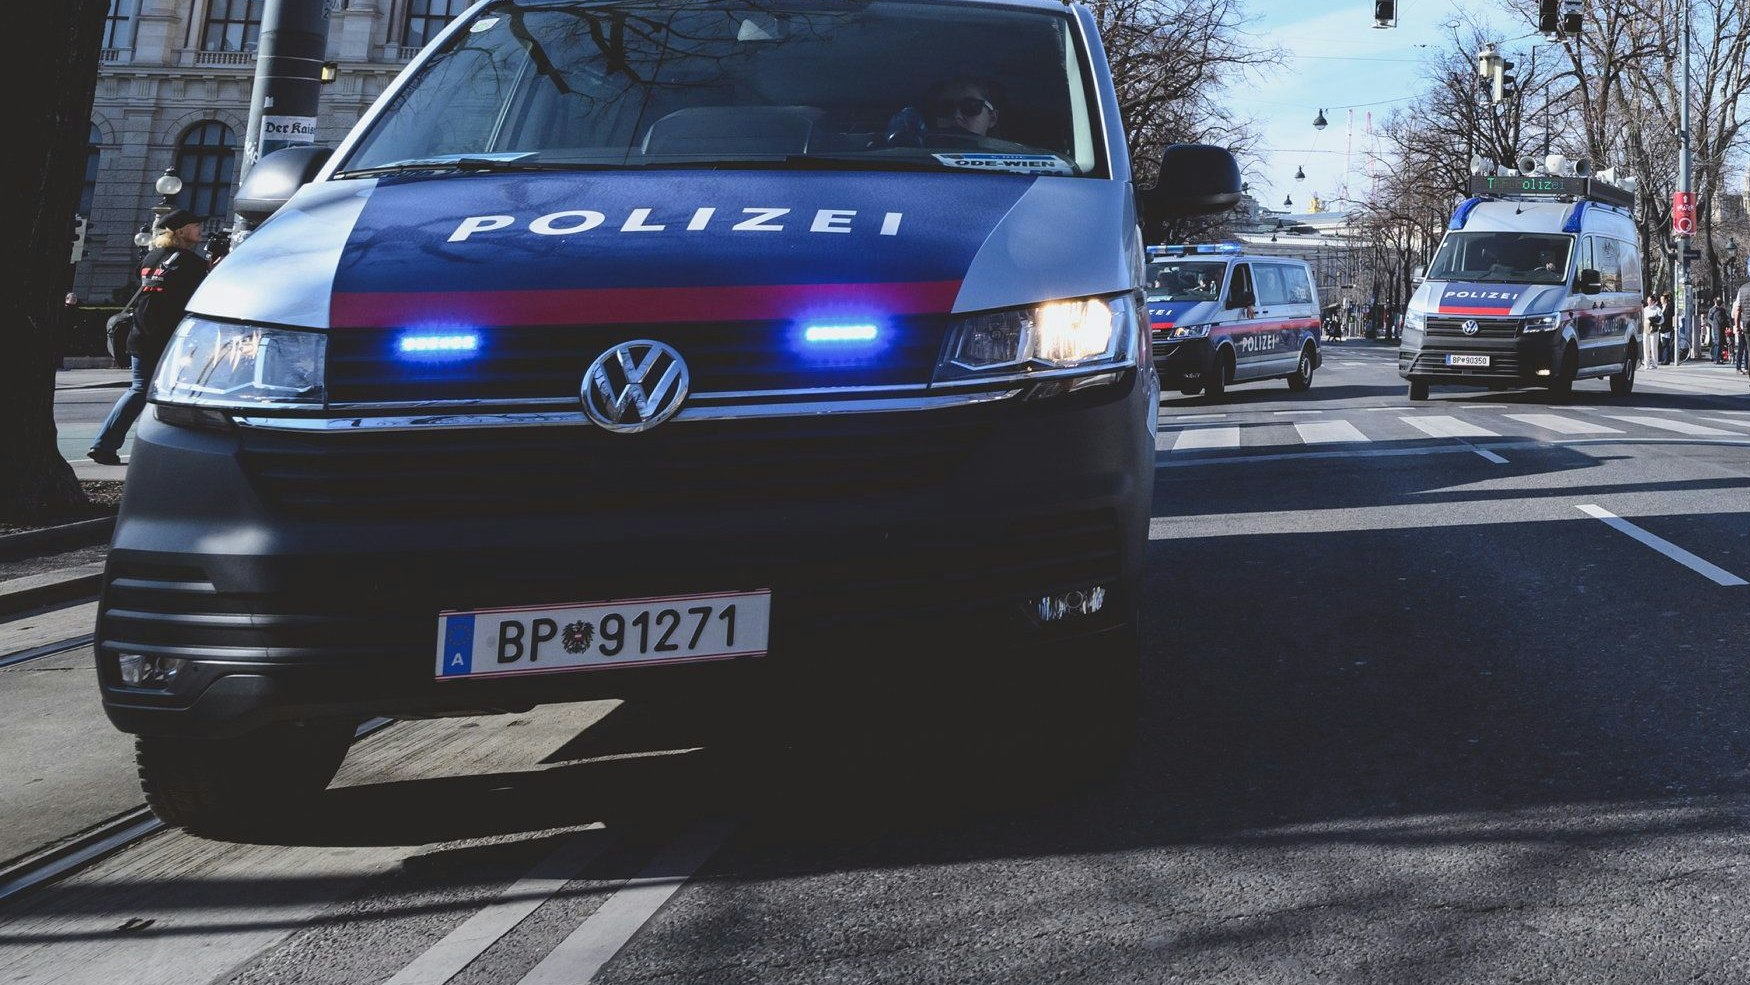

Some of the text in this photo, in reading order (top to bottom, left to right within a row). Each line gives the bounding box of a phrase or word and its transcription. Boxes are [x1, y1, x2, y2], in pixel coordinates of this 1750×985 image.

[265, 122, 289, 134] Der
[447, 207, 903, 243] POLIZEI
[1444, 290, 1519, 301] POLIZEI
[1242, 334, 1275, 353] POLIZEI
[451, 603, 736, 666] A BP 91271
